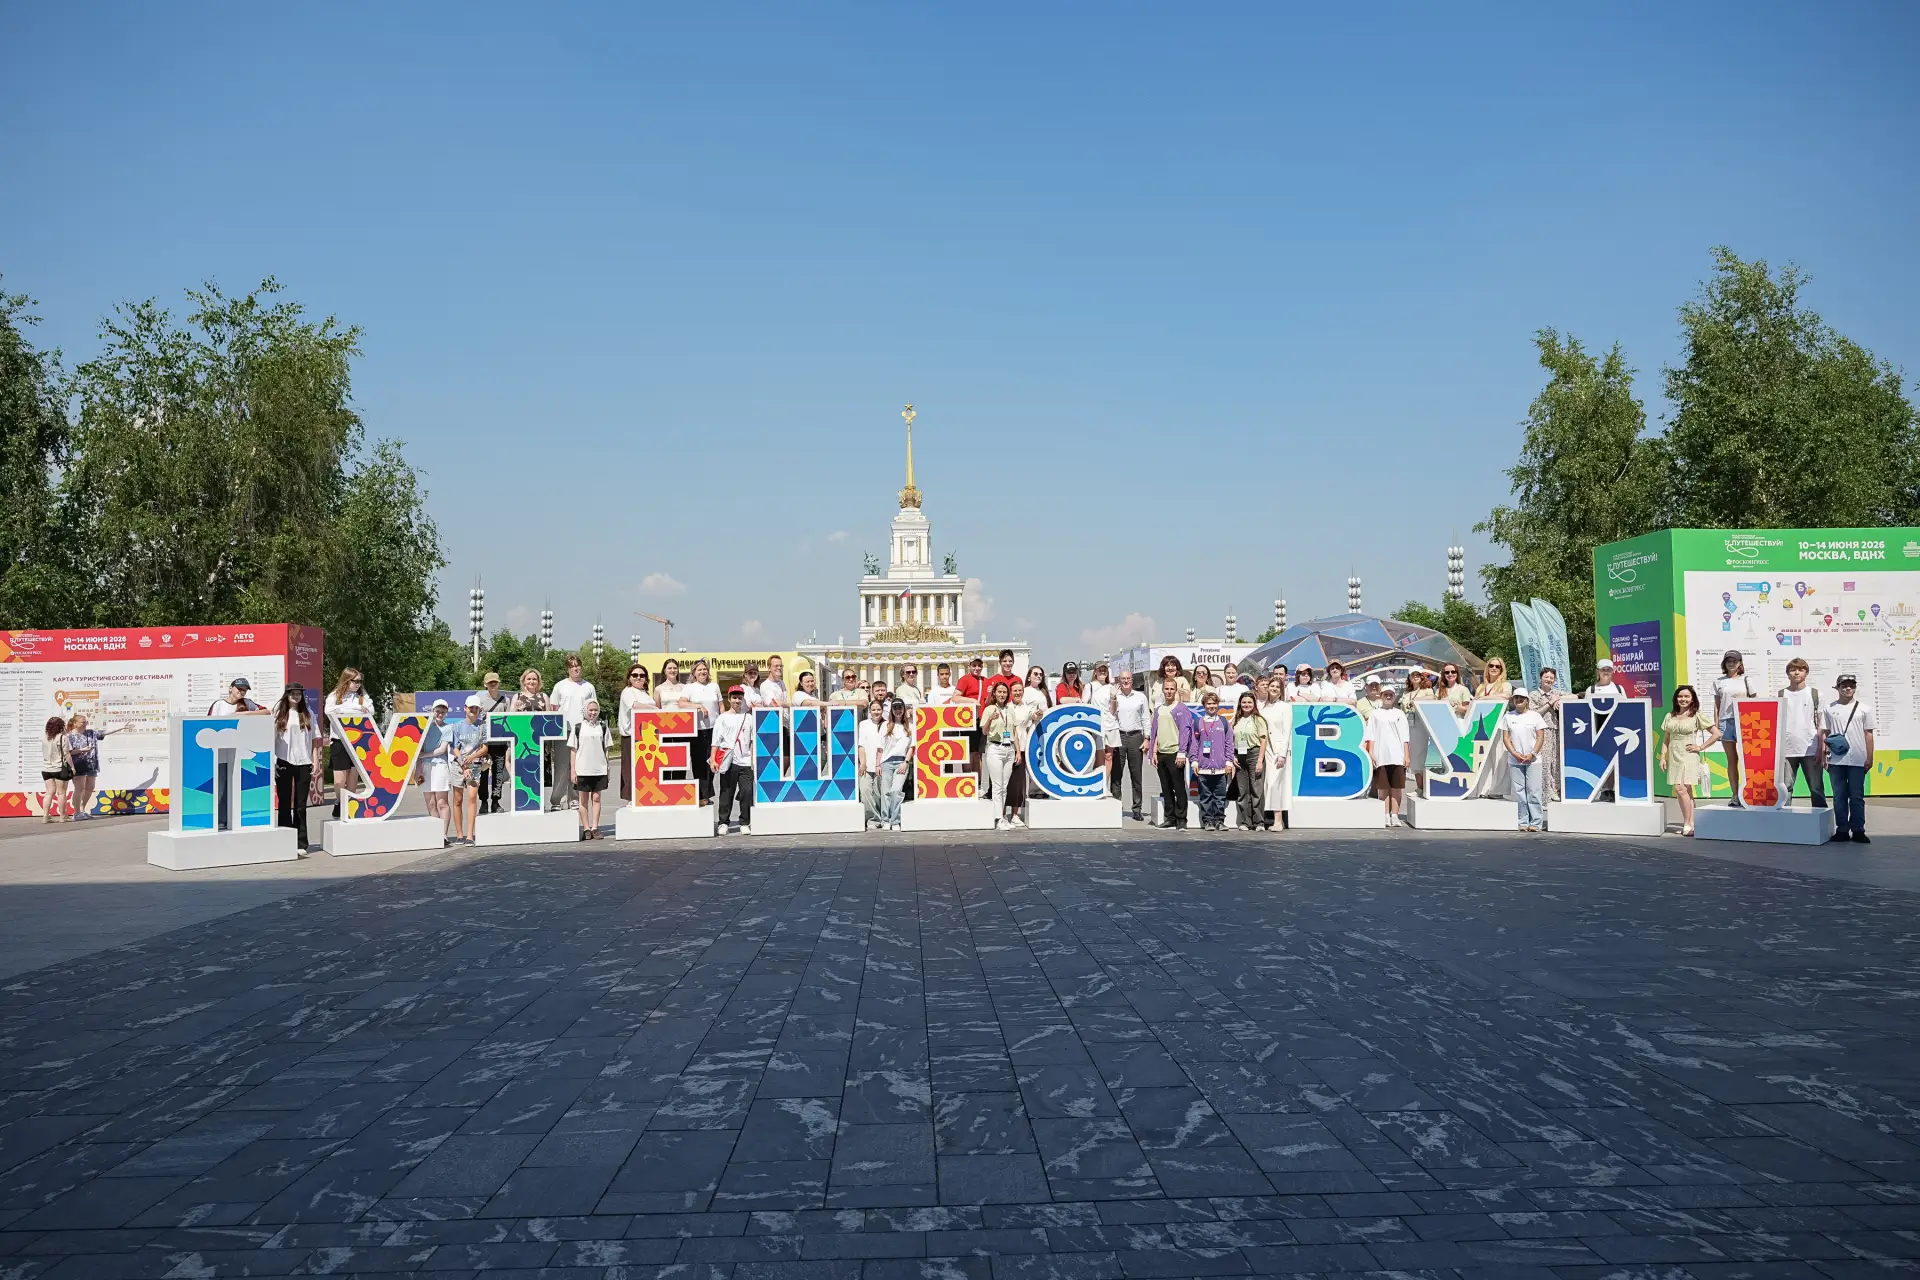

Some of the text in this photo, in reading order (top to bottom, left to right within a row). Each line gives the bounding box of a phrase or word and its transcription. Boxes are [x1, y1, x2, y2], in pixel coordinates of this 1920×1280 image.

[1731, 539, 1784, 547] ПУТЕШЕСТВУЙ!
[1828, 541, 1859, 550] ИЮНЯ
[1861, 540, 1885, 549] 2026
[1611, 552, 1658, 570] ПУТЕШЕСТВУЙ!
[1799, 551, 1885, 561] МОСКВА, ВДНХ
[63, 642, 127, 651] МОСКВА, ВДНХ
[1190, 652, 1231, 665] Дагестан
[1612, 650, 1644, 662] ВЫБИРАЙ
[1613, 661, 1660, 673] РОССИЙСКОЕ!
[134, 673, 174, 681] ФЕСТИВАЛЯ
